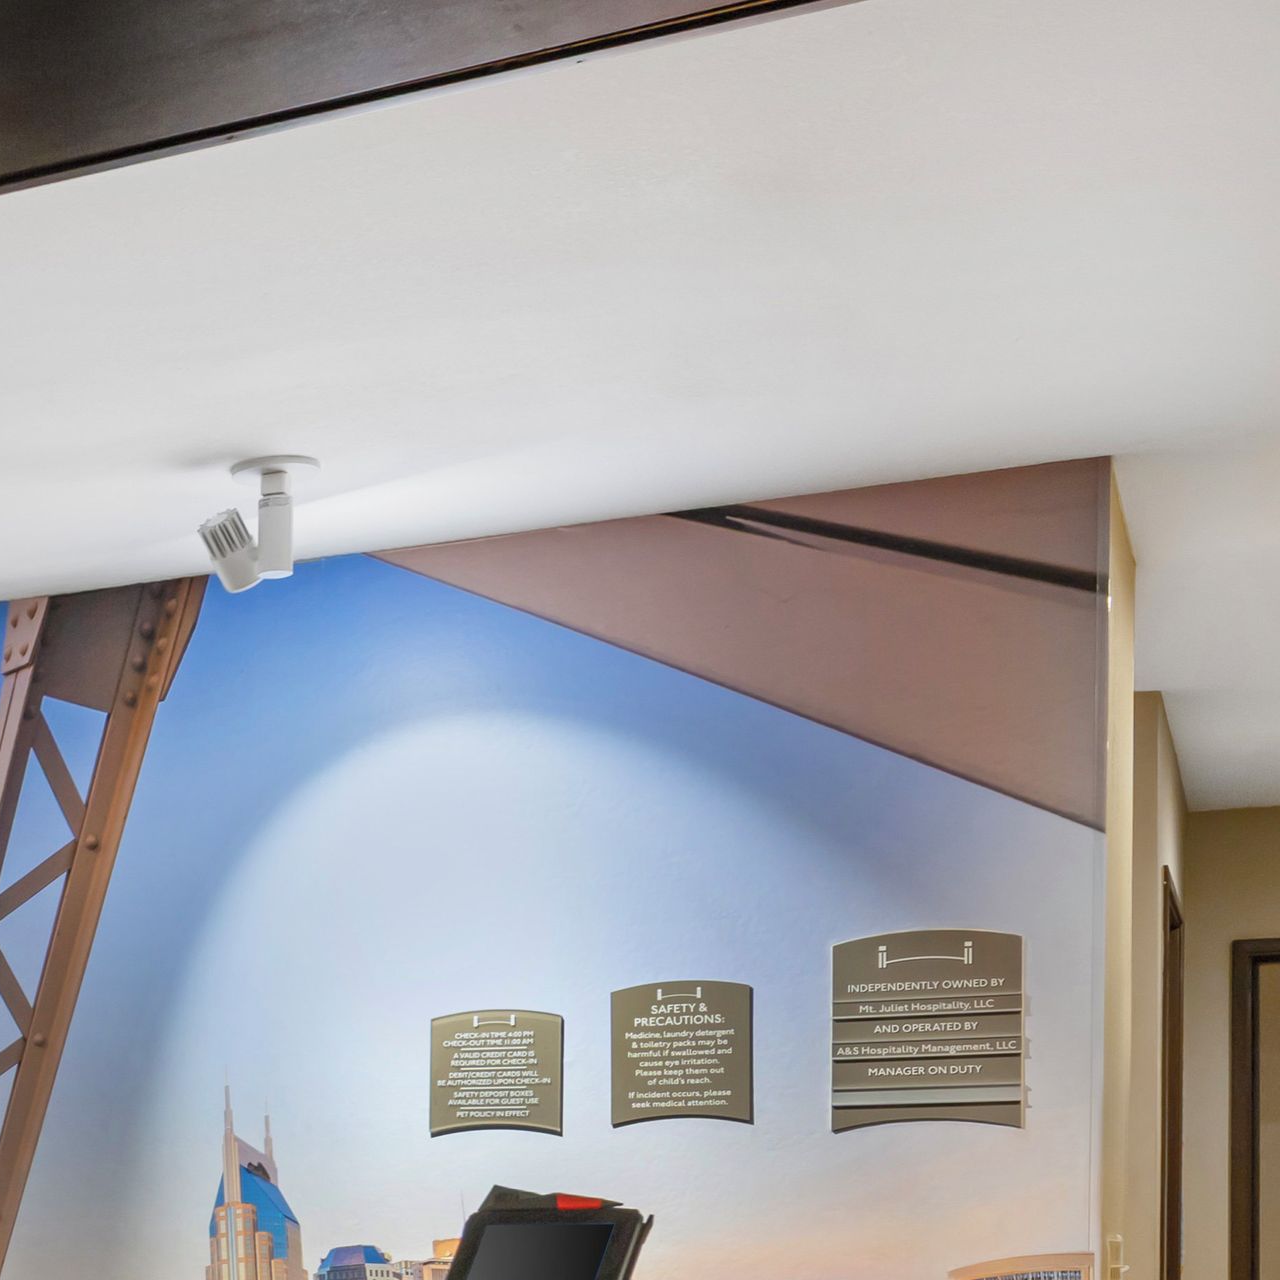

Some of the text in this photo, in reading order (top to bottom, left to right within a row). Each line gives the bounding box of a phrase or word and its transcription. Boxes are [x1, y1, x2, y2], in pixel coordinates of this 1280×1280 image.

[847, 977, 1006, 993] INDEPENDENTLY OWNED BY
[651, 1002, 708, 1014] SAFETY &
[859, 999, 994, 1014] Mt. Juliet Hospitality, LLC
[634, 1014, 725, 1027] PRECAUTIONS:
[874, 1021, 979, 1034] AND OPERATED BY
[625, 1028, 735, 1040] Medicine, laundry detergent
[640, 1040, 672, 1049] toiletry
[672, 1040, 696, 1048] packs
[698, 1039, 715, 1047] may
[837, 1040, 1017, 1056] A&S Hospitality Management, LLC
[627, 1050, 661, 1058] harmful
[670, 1048, 716, 1056] swallowed
[716, 1047, 733, 1055] and
[665, 1060, 680, 1068] eye
[681, 1058, 720, 1066] irritation.
[448, 1071, 496, 1079] DEBIT/CREDIT
[635, 1069, 662, 1077] Please
[663, 1068, 684, 1077] keep
[868, 1064, 983, 1076] MANAGER ON DUTY
[686, 1077, 713, 1085] reach.
[636, 1090, 670, 1098] incident
[703, 1089, 732, 1098] please
[631, 1099, 729, 1109] seek medical attention.
